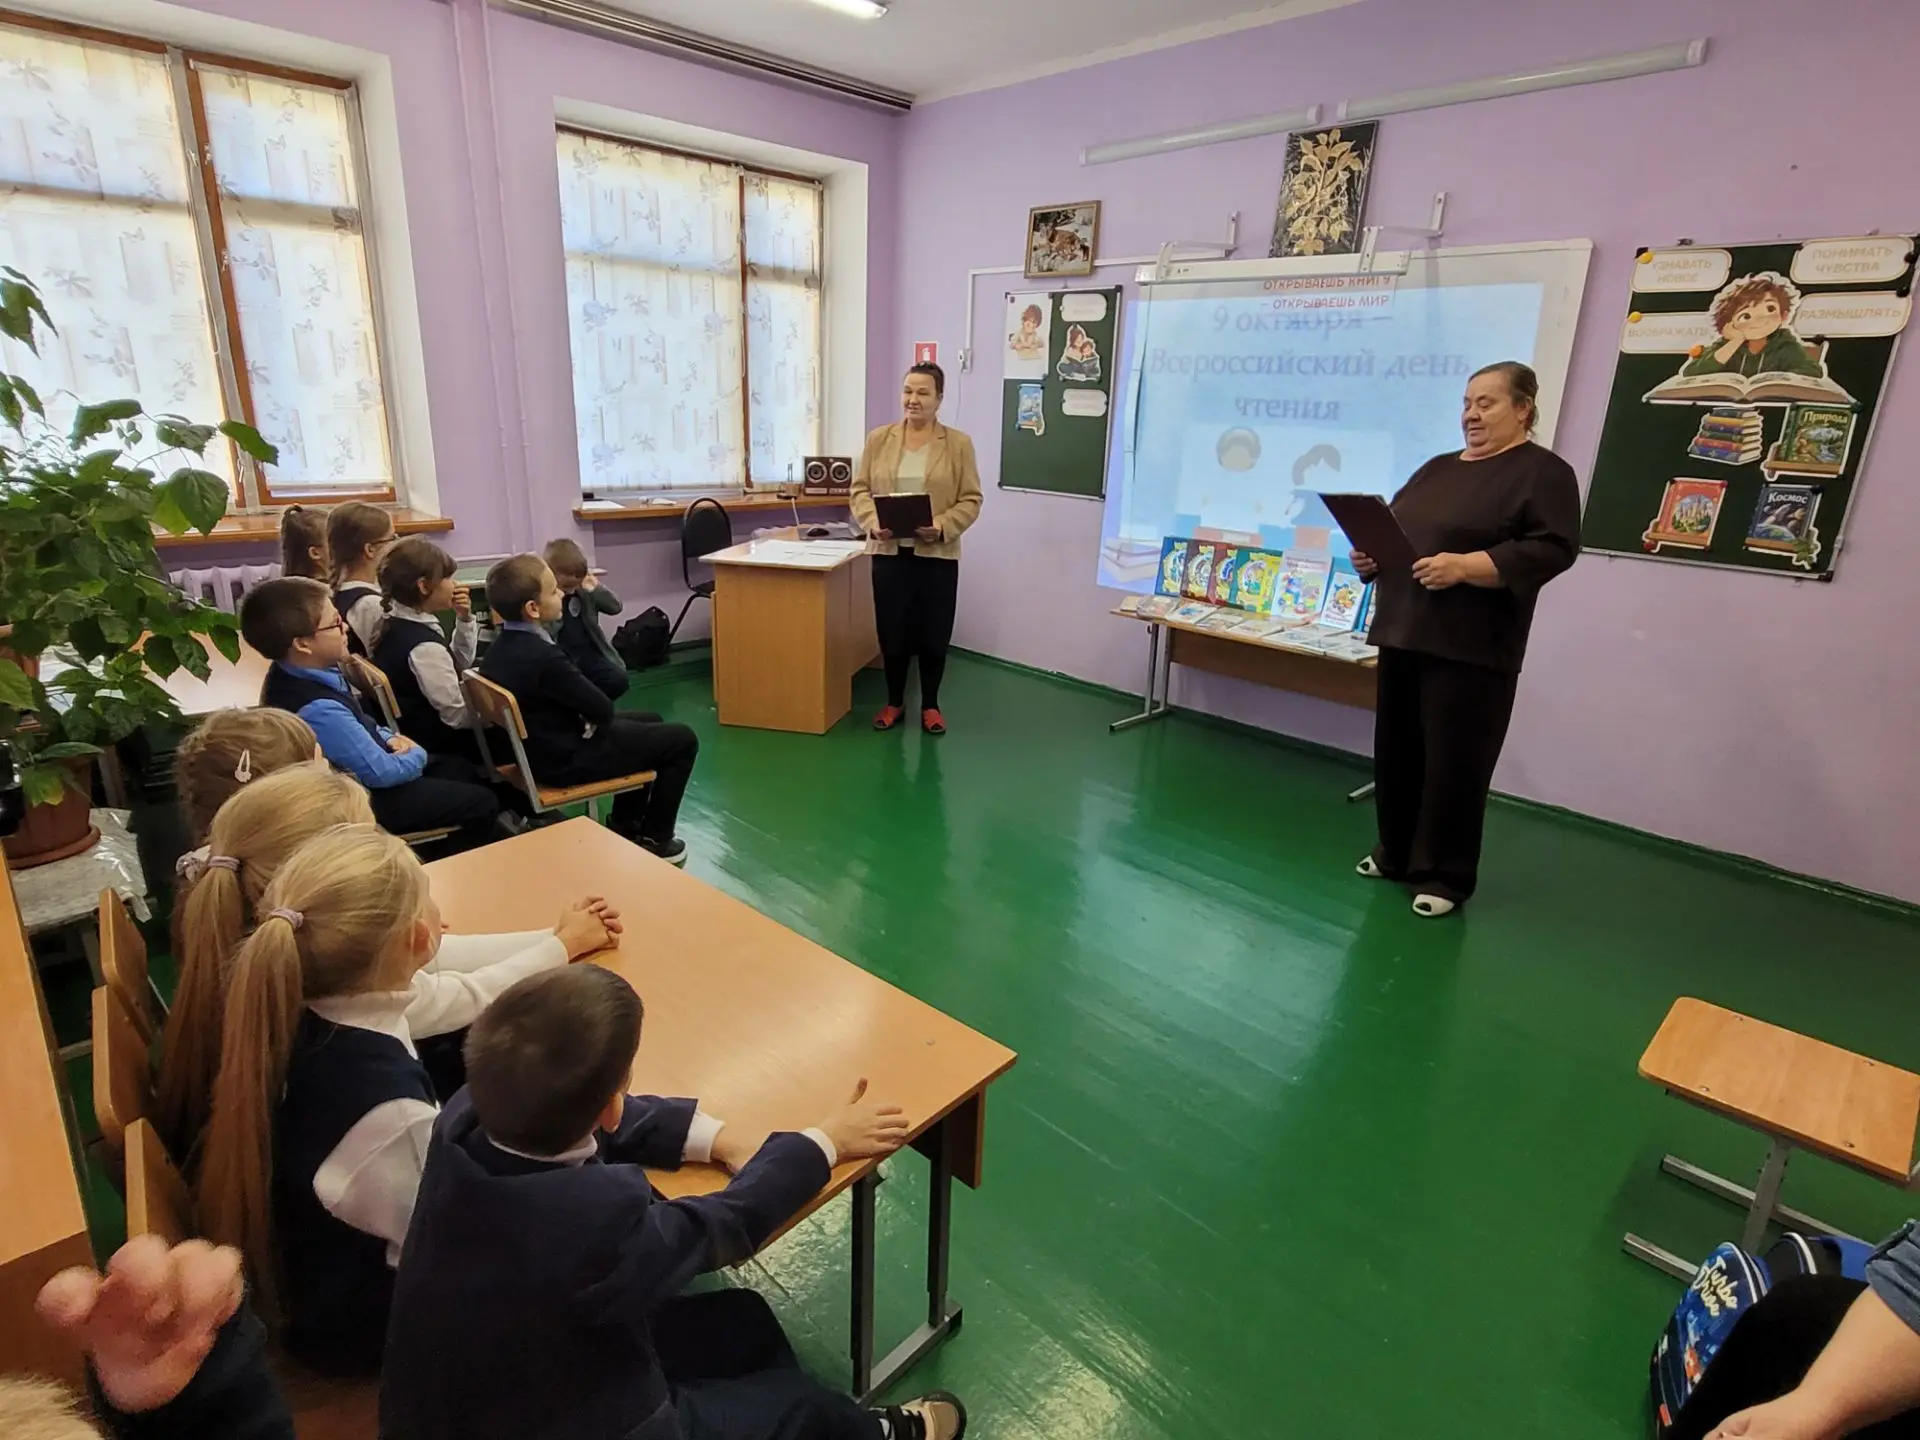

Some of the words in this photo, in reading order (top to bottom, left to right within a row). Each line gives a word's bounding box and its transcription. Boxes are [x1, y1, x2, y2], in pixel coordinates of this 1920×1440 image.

[1812, 246, 1893, 260] ПОНИМАТЬ
[1815, 261, 1880, 273] ЧУВСТВА
[1263, 277, 1345, 291] ОТКРЫВАЕШЬ
[1348, 275, 1391, 287] КНИГУ
[1272, 296, 1356, 310] ОТКРЫВАЕШЬ
[1358, 294, 1390, 307] МИР
[1213, 306, 1229, 332] 9
[1800, 307, 1902, 319] РАЗМЫШЛЯТЬ
[1150, 347, 1376, 382] Всероссийский
[1384, 353, 1470, 380] день
[1235, 397, 1340, 421] чтения
[1803, 411, 1848, 426] Природа
[1767, 491, 1809, 505] Космос
